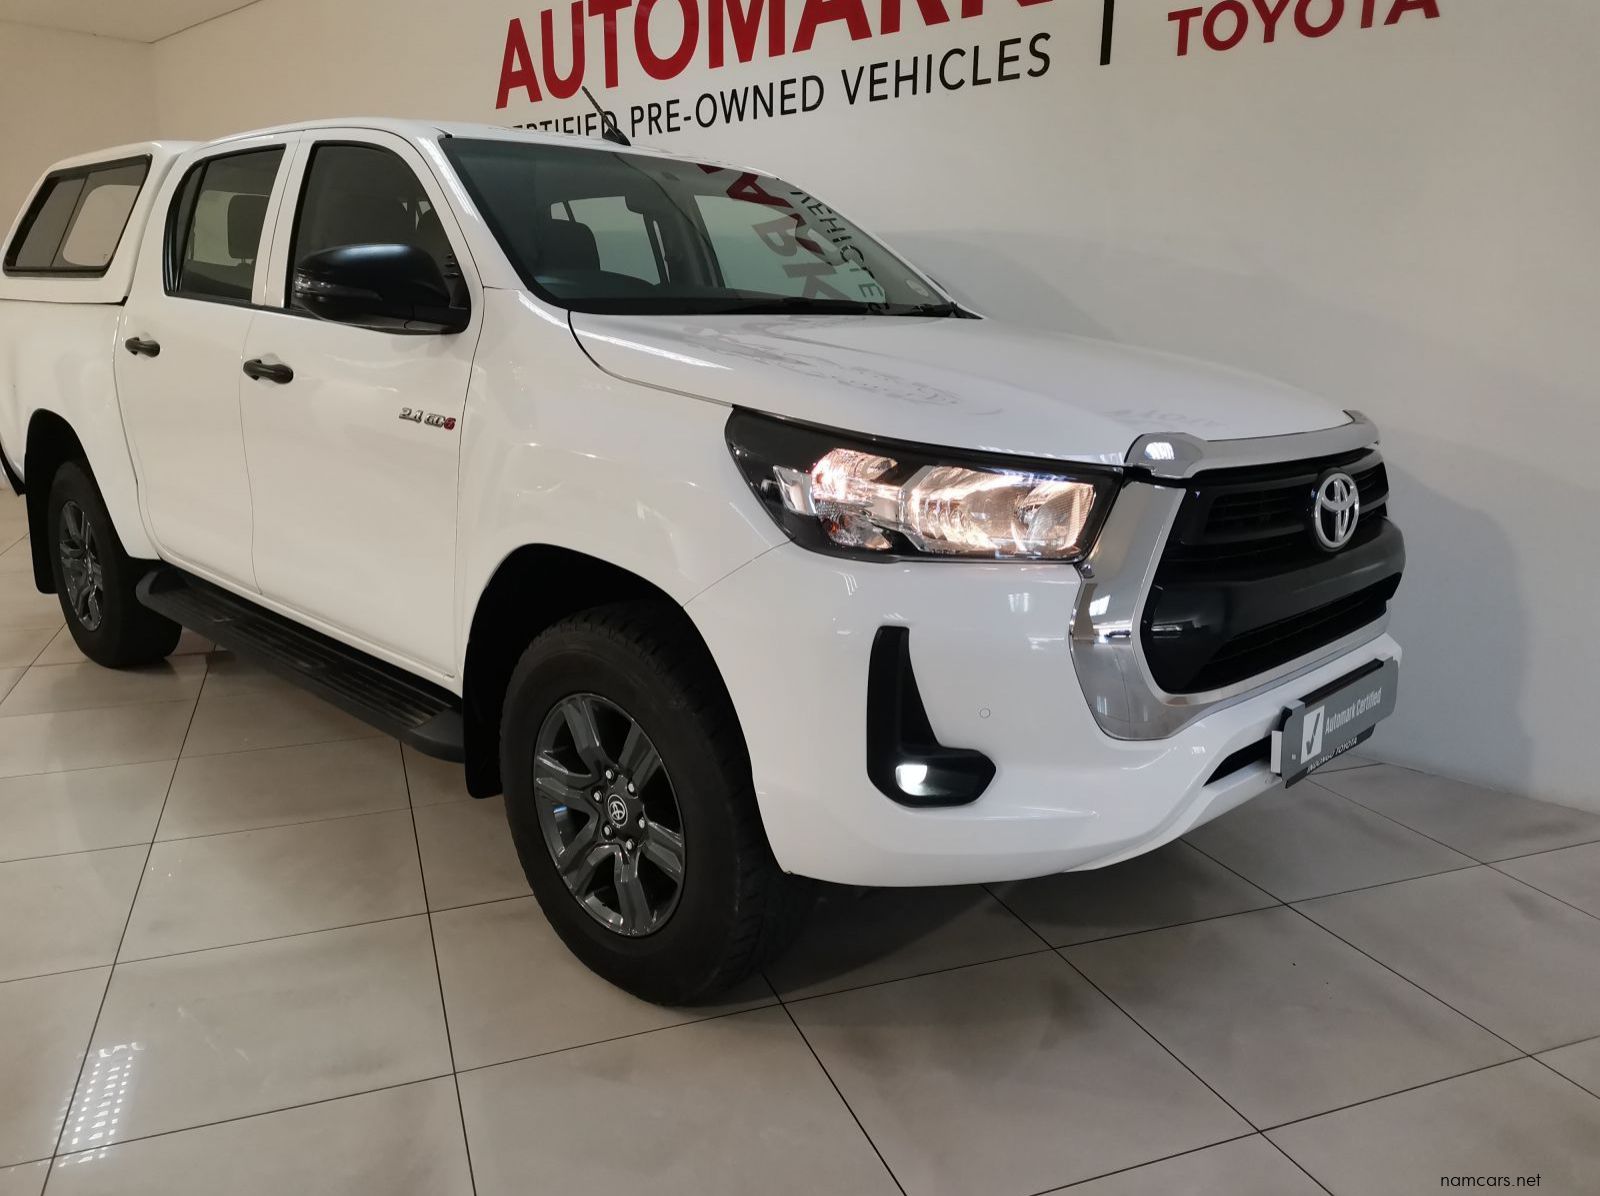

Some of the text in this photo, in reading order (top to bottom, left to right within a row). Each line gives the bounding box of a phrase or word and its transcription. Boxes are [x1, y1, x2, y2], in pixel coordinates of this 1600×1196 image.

[496, 0, 1053, 109] AUTOM
[631, 75, 825, 138] PRE-OWNED
[841, 32, 1052, 105] VEHICLES
[1324, 687, 1382, 735] Automark Certified
